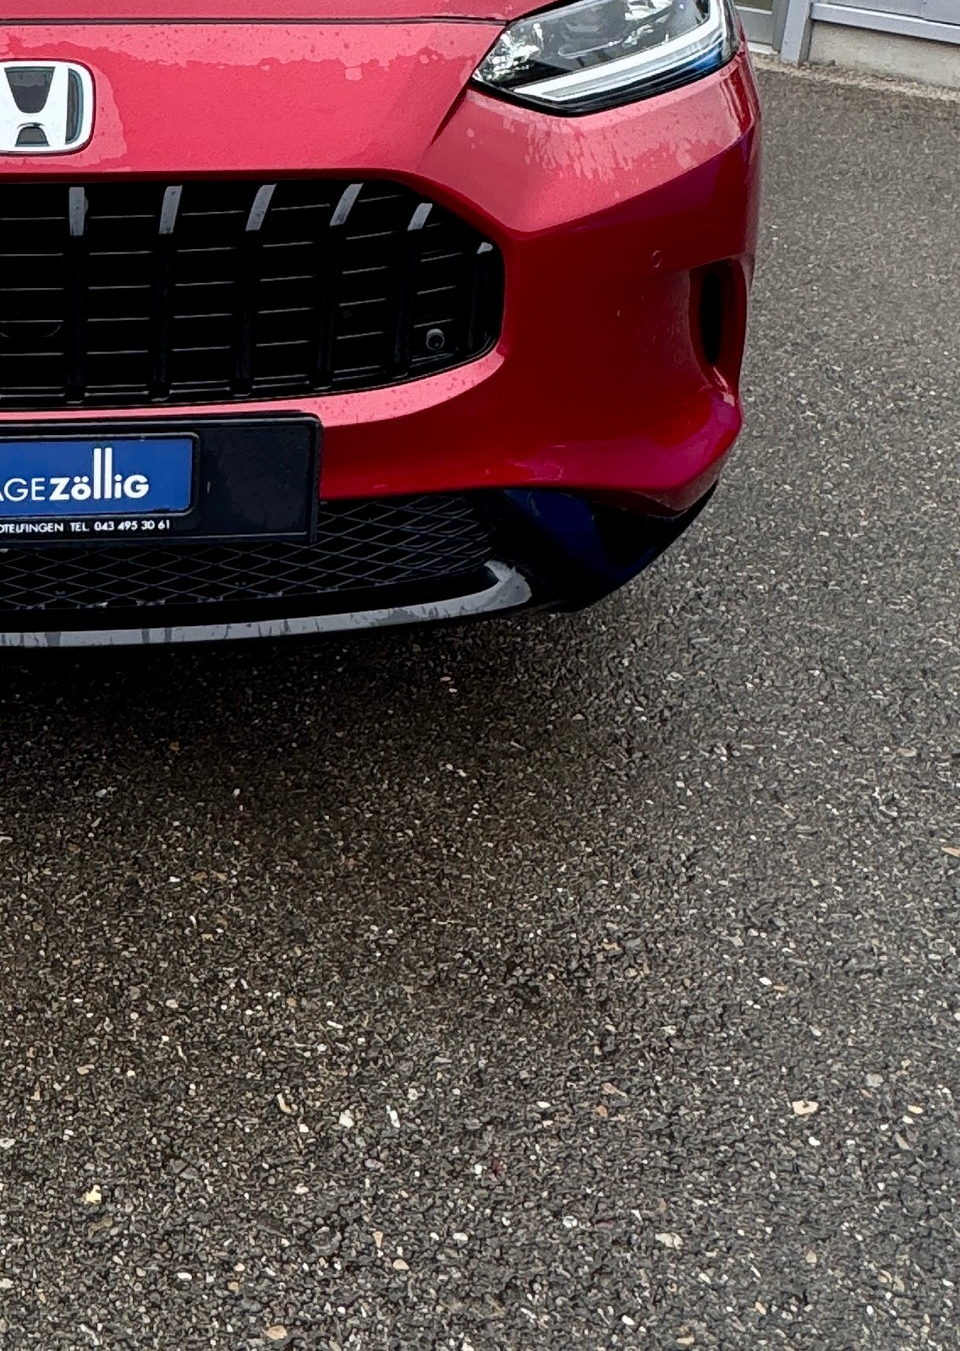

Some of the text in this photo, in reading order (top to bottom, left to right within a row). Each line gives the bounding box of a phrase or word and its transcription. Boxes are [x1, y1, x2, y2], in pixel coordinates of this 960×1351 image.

[94, 521, 115, 532] 043
[117, 520, 138, 532] 495
[141, 520, 156, 531] 30
[158, 519, 171, 531] 61
